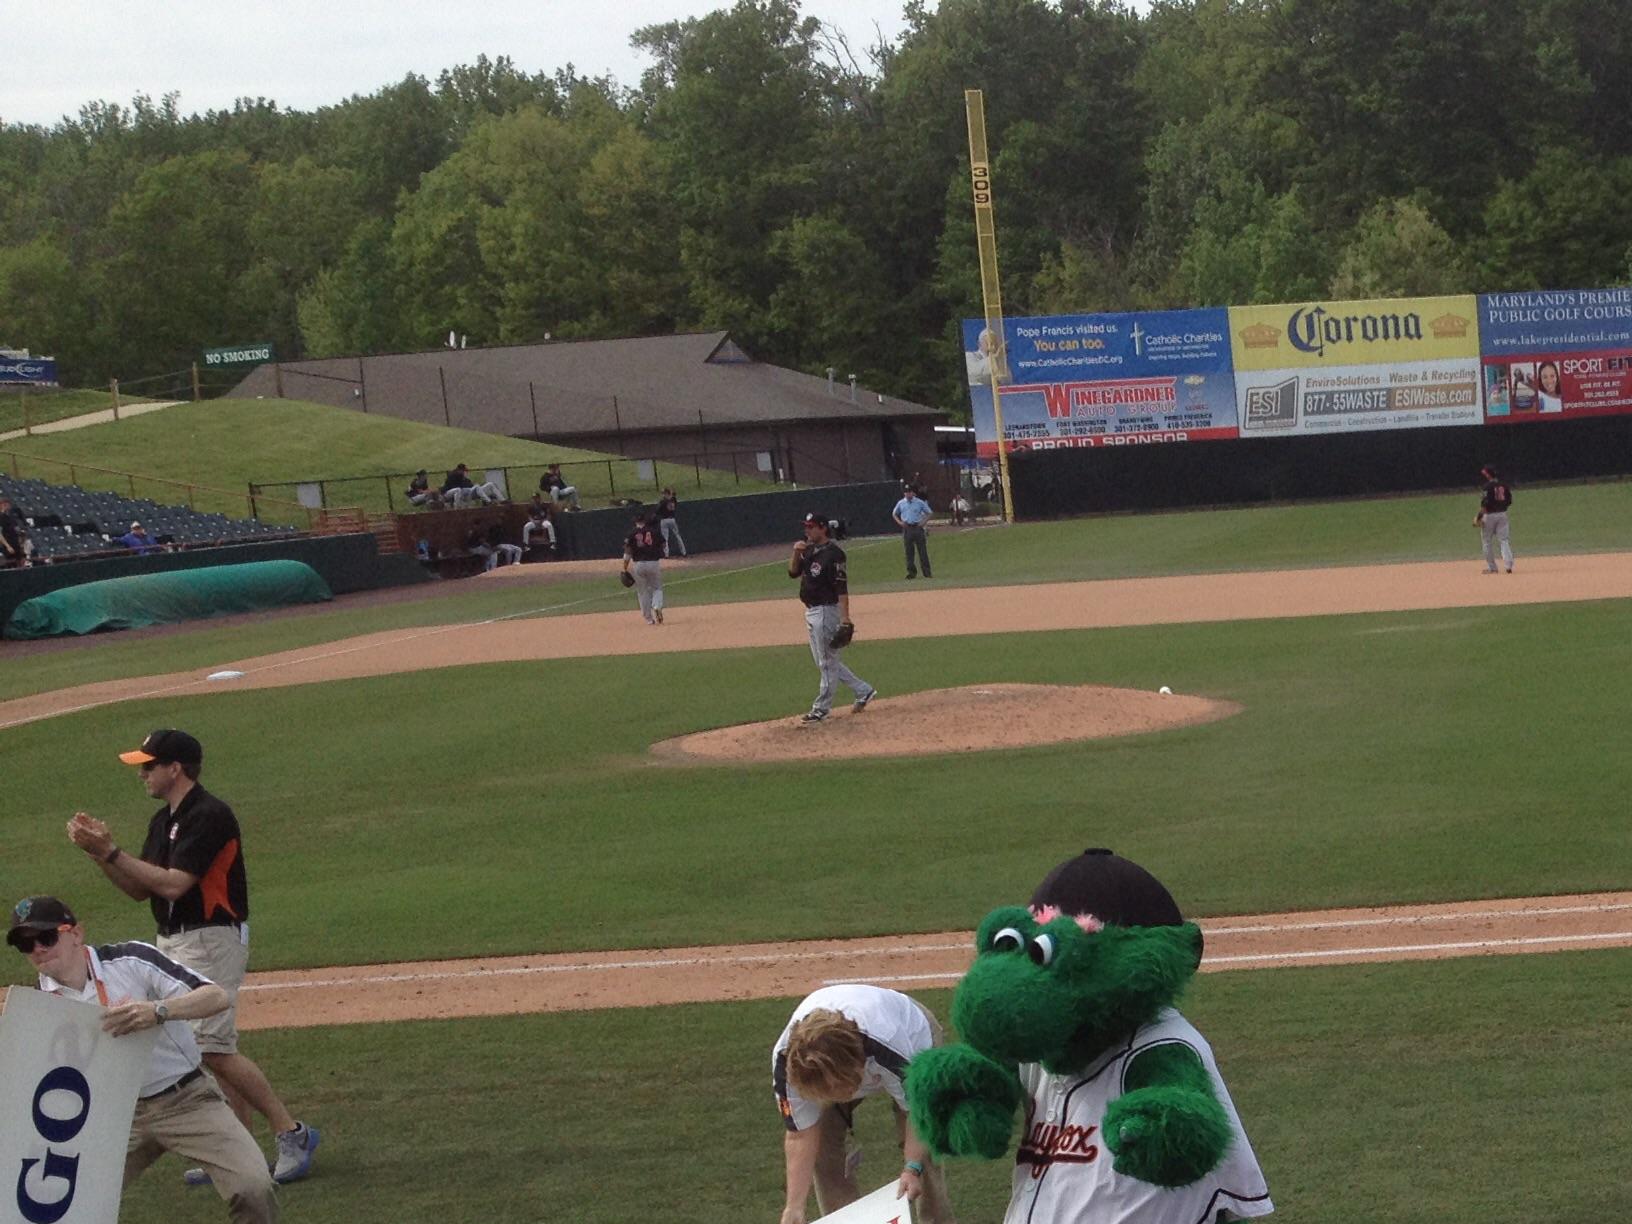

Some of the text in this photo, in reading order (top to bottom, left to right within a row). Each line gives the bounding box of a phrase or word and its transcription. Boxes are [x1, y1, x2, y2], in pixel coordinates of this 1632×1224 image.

[973, 167, 990, 204] 309
[1488, 293, 1577, 308] MARYLAND'S
[1489, 308, 1541, 323] PUBLIC
[1544, 307, 1581, 321] GOLF
[1017, 324, 1118, 340] Pope Francis visited us.
[1287, 305, 1423, 356] Corona
[1034, 338, 1105, 351] You can too.
[1146, 333, 1223, 345] Catholic Charities
[205, 349, 269, 365] NO SMOKING
[1563, 358, 1604, 374] SPORT
[1305, 368, 1476, 388] EnviroSolutions Waste & Recycling
[1043, 383, 1177, 420] WINEGARDNER
[1248, 390, 1281, 416] ESI
[1393, 388, 1473, 408] ESIWaste.com
[1076, 405, 1116, 418] AUTO
[1127, 402, 1177, 416] GROUP
[17, 1066, 91, 1224] GO
